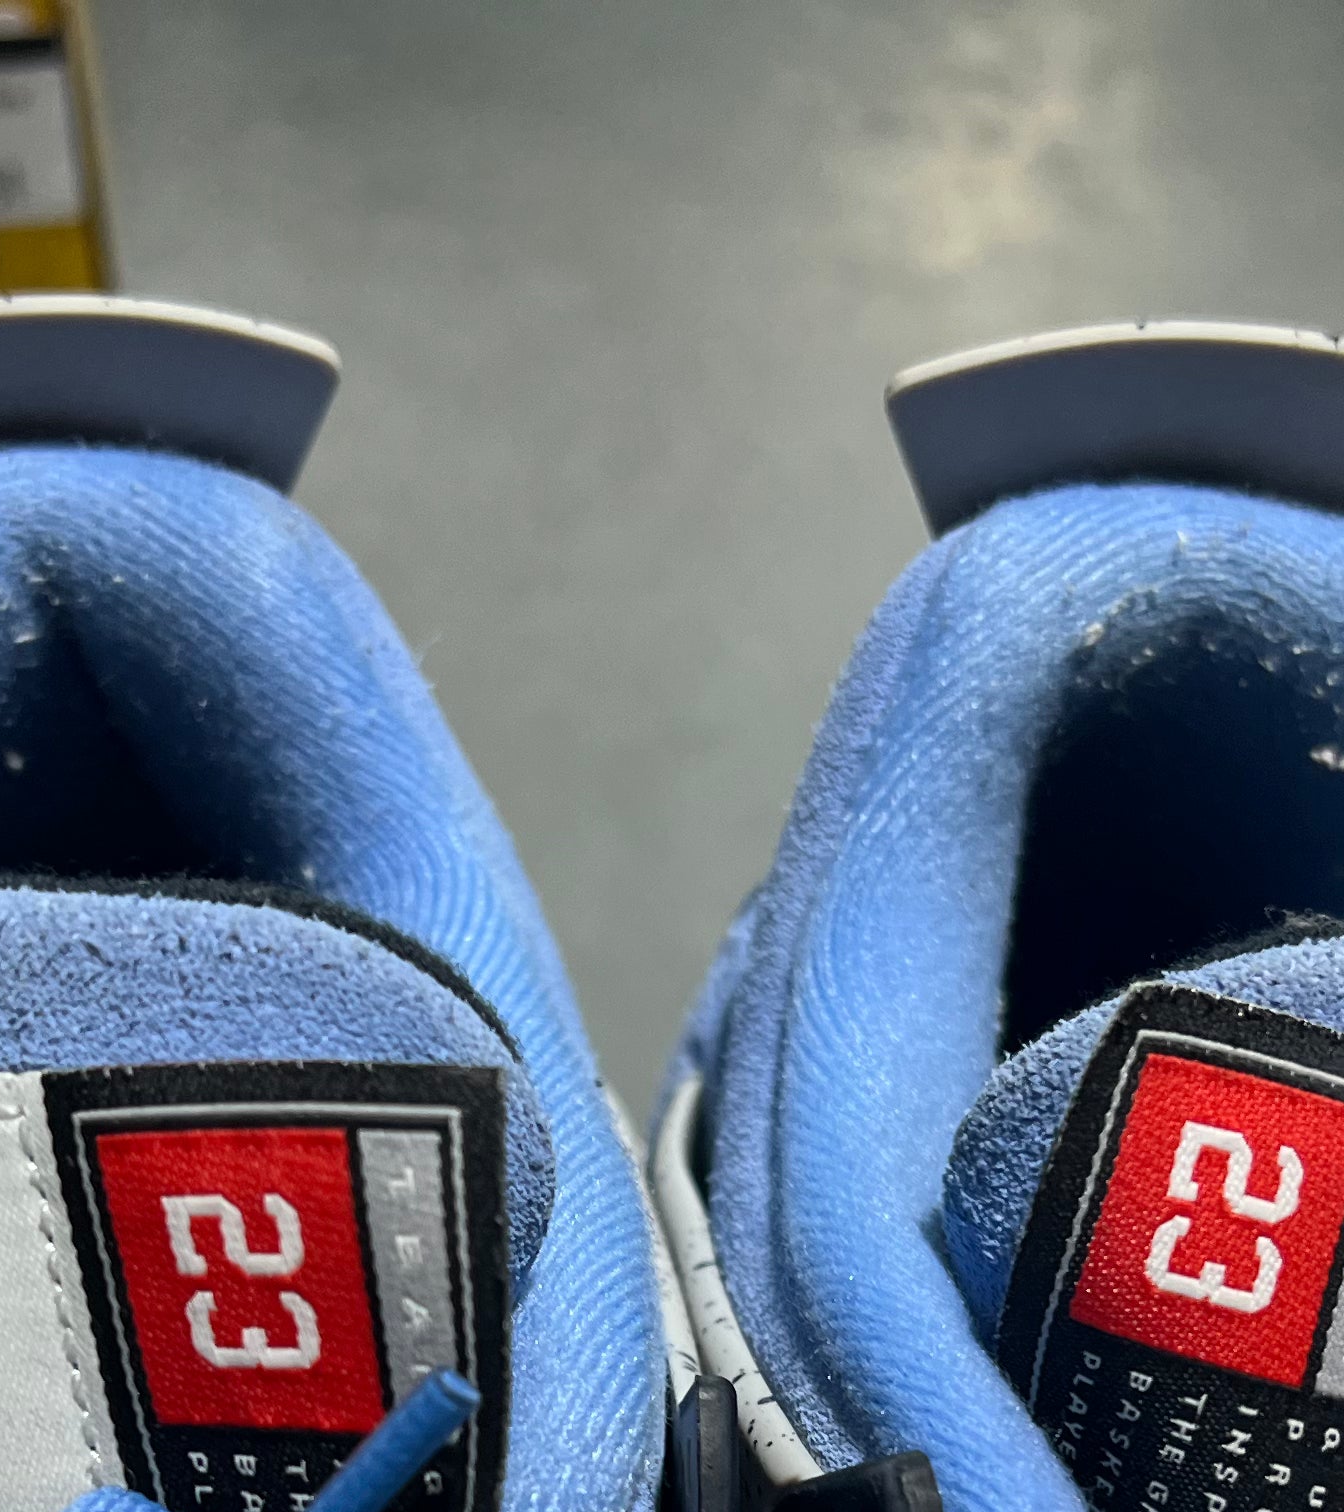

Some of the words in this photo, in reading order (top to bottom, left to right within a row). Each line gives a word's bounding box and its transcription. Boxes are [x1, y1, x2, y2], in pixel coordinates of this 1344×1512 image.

[161, 1191, 322, 1371] 23
[387, 1166, 433, 1380] TEA
[1144, 1120, 1305, 1314] 23
[1058, 1350, 1102, 1461] PLAYE
[1158, 1393, 1208, 1466] THE
